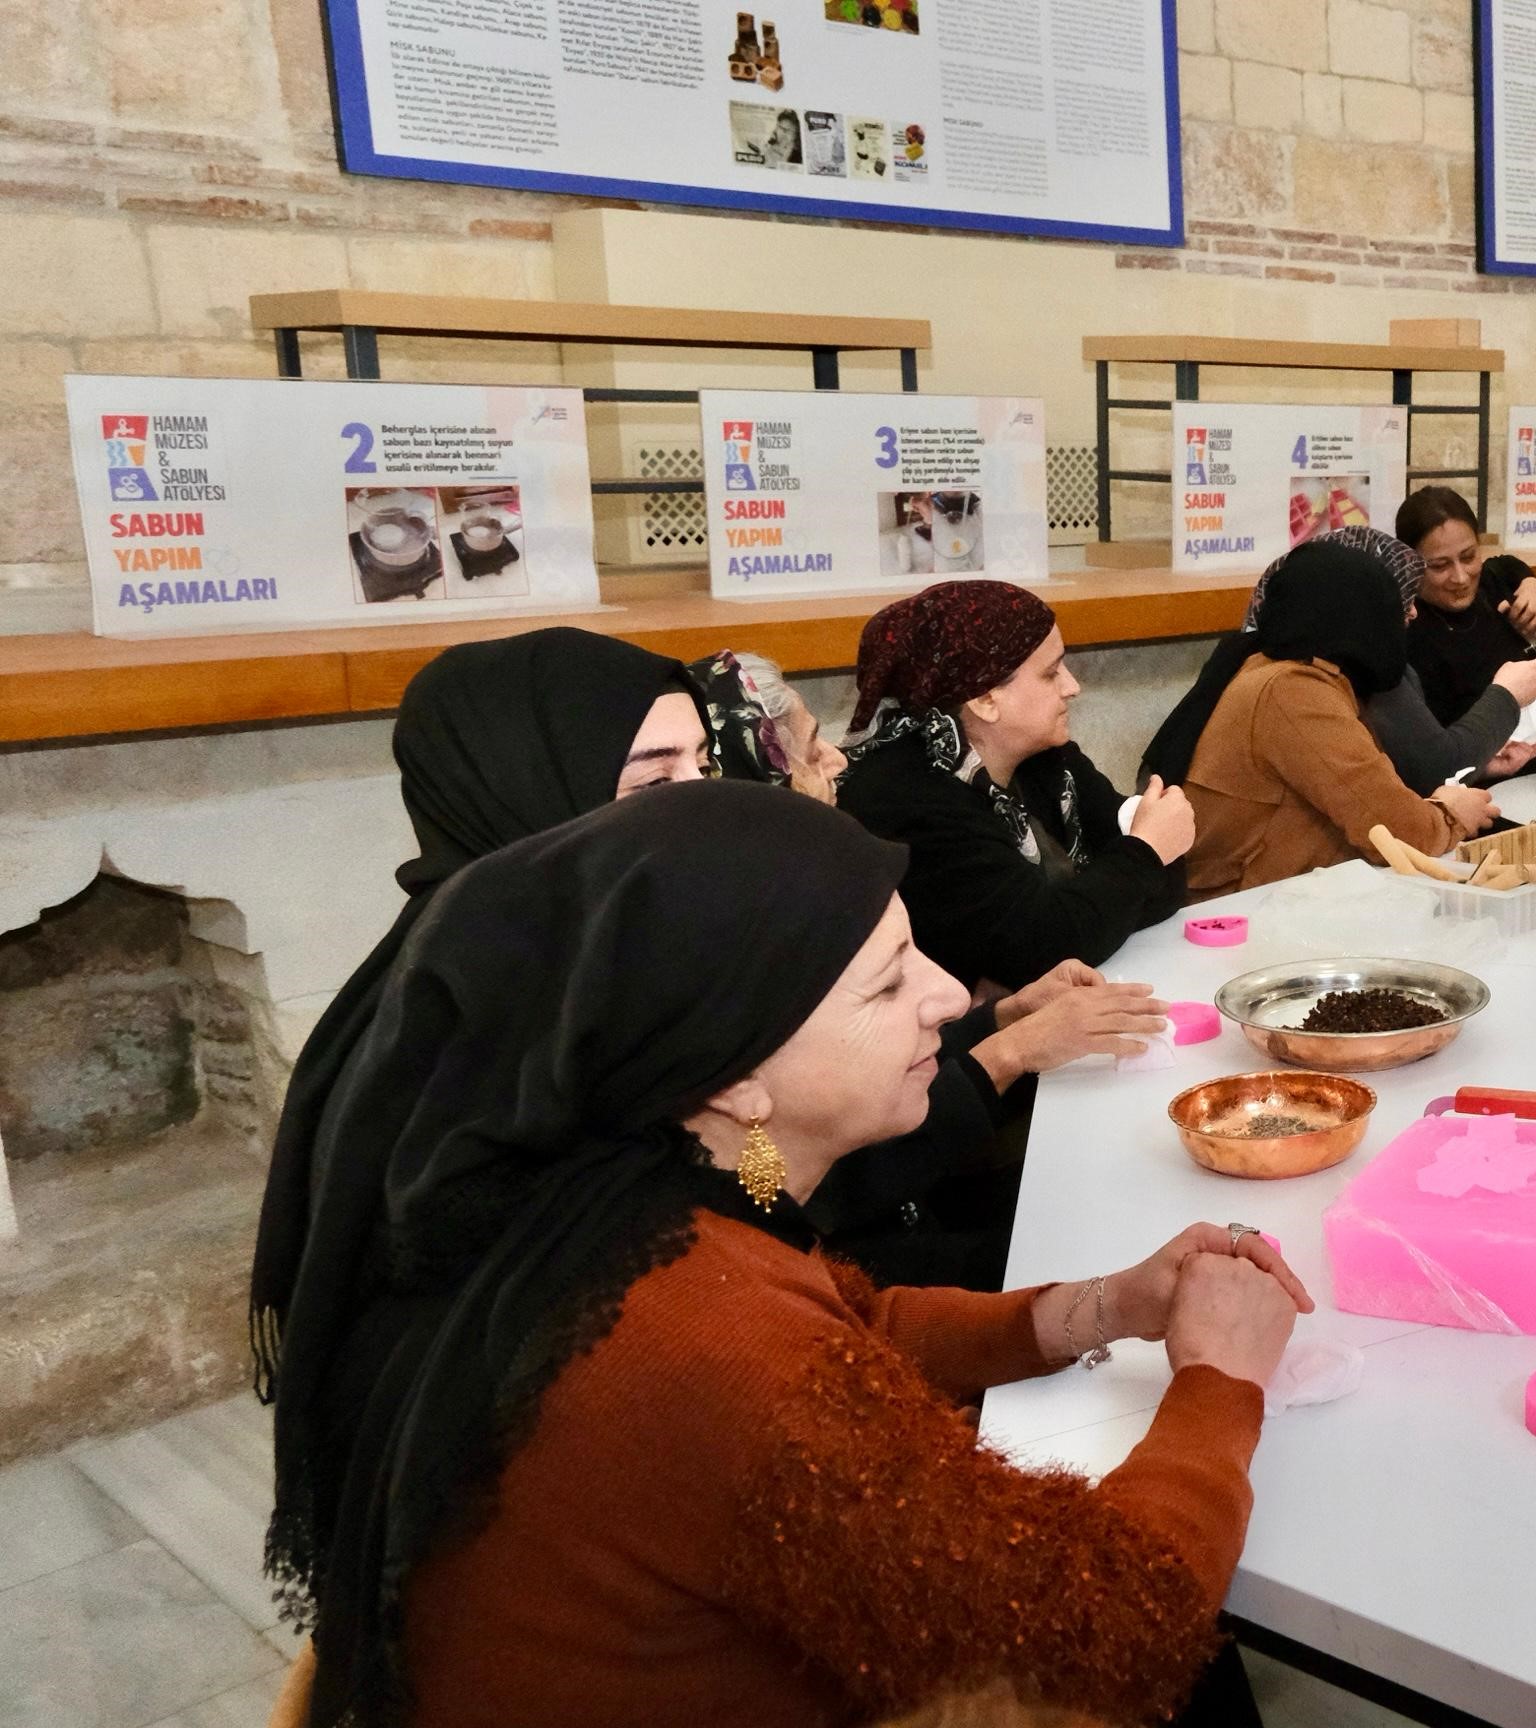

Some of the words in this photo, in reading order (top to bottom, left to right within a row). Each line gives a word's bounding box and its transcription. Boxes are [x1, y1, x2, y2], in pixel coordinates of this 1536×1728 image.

[152, 416, 208, 432] HAMAM
[382, 425, 427, 436] Beherglas
[756, 422, 792, 435] HAMAM
[154, 433, 208, 450] MÜZESİ
[340, 421, 377, 474] 2
[383, 438, 410, 447] sabun
[875, 426, 899, 469] 3
[158, 451, 171, 466] &
[758, 450, 766, 463] &
[1292, 435, 1309, 469] 4
[160, 469, 208, 484] SABUN
[759, 464, 790, 477] SABUN
[163, 485, 226, 500] ATÖLYESİ
[1184, 493, 1226, 509] SABUN
[723, 500, 785, 520] SABUN
[110, 513, 204, 538] SABUN
[1184, 515, 1223, 532] YAPIM
[725, 528, 783, 548] YAPIM
[1184, 537, 1255, 560] AŞAMALARI
[114, 547, 203, 572] YAPIM
[728, 553, 833, 582] AŞAMALARI
[118, 577, 278, 614] AŞAMALARI
